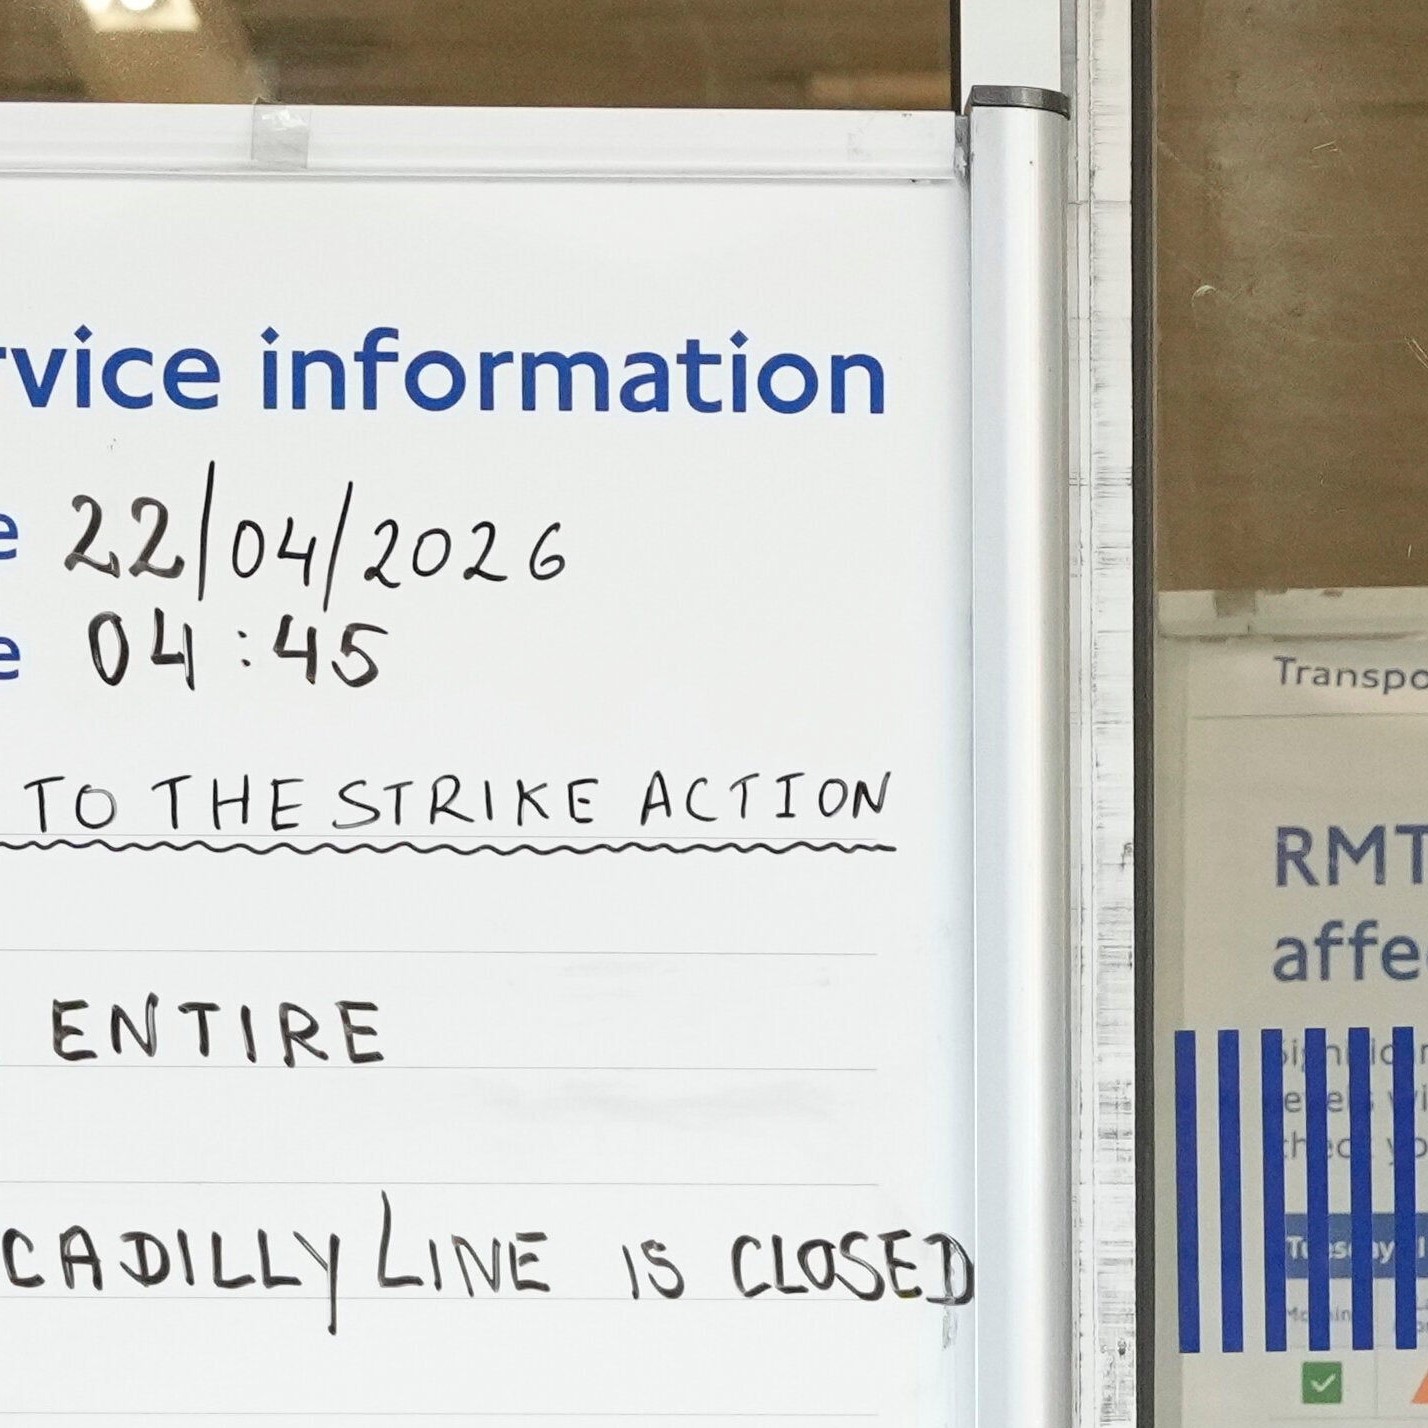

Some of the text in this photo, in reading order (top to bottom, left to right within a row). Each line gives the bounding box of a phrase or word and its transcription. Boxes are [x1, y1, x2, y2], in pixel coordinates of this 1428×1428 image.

[261, 327, 884, 414] information
[64, 461, 565, 608] 22/04/2026
[24, 776, 115, 833] TO
[152, 775, 302, 831] THE
[332, 775, 598, 829] STRIKE
[641, 771, 891, 825] ACTION
[52, 993, 384, 1067] ENTIRE
[378, 1191, 550, 1297] LINE
[622, 1240, 684, 1300] IS
[732, 1229, 974, 1305] CLOSED
